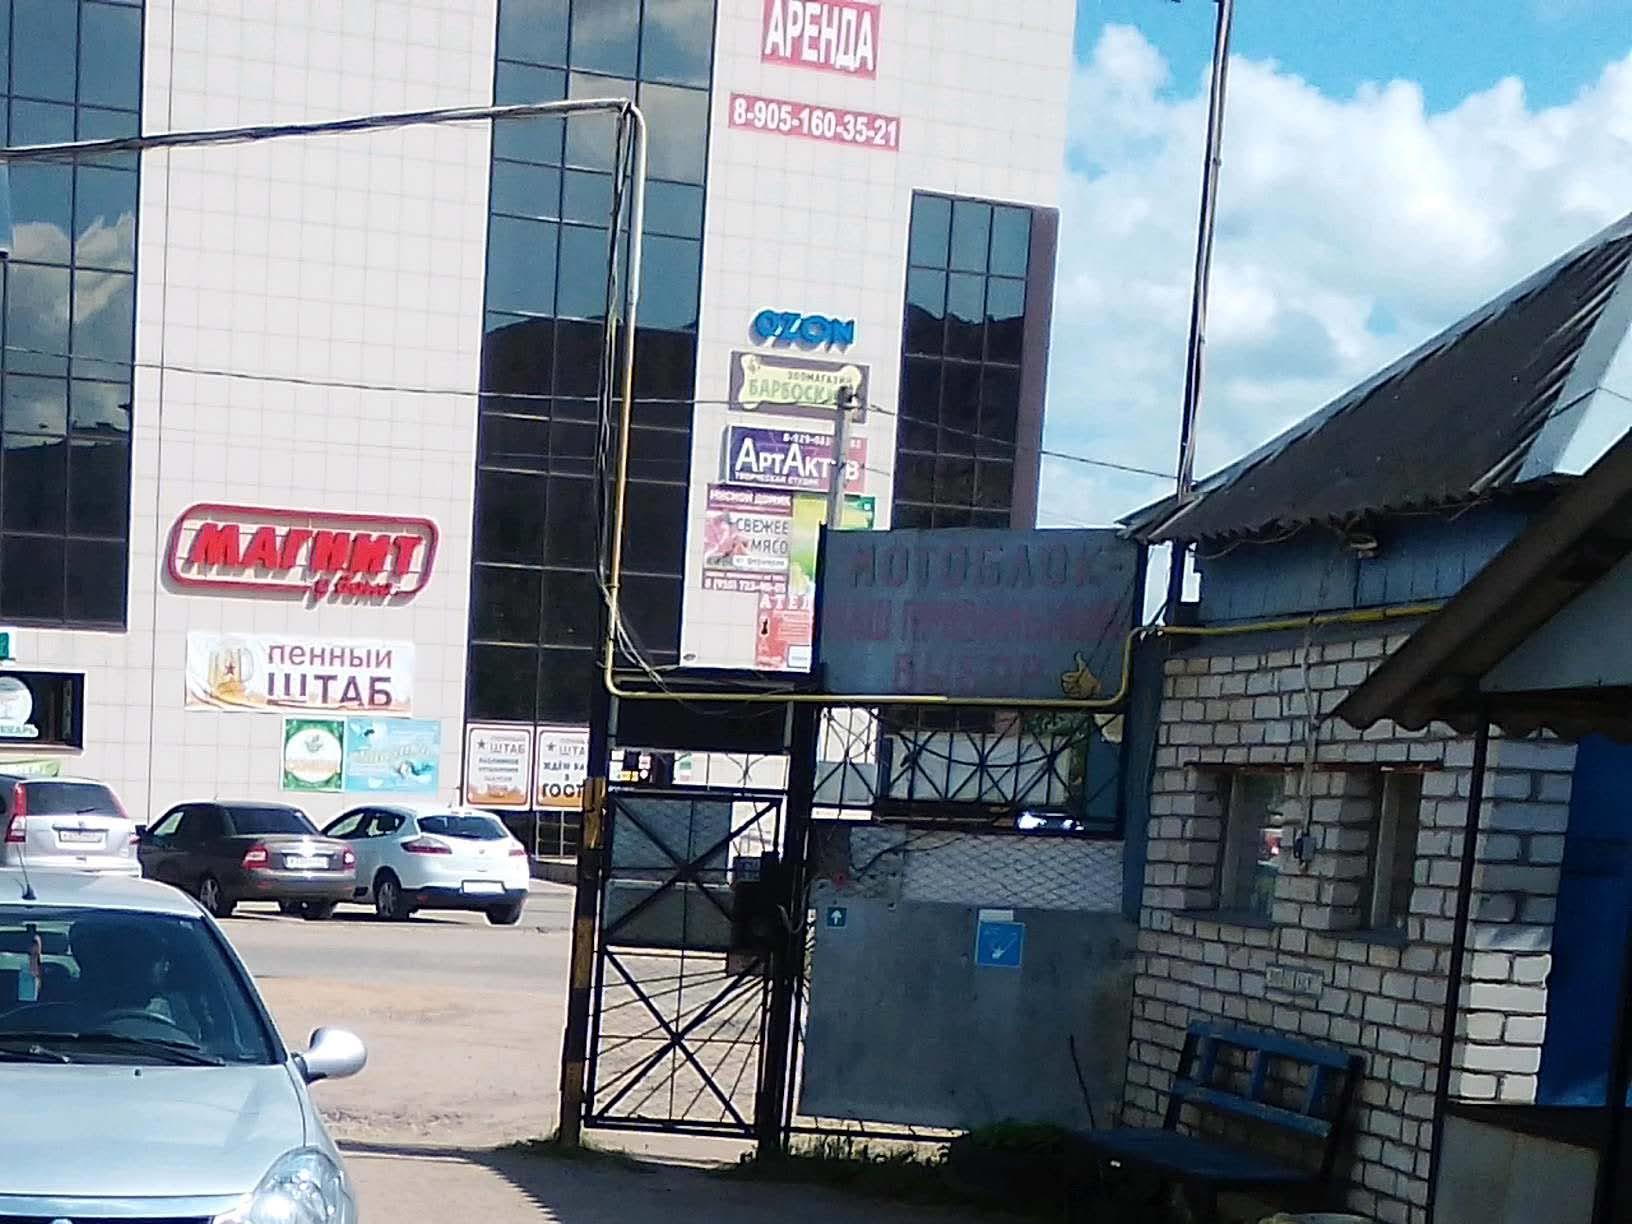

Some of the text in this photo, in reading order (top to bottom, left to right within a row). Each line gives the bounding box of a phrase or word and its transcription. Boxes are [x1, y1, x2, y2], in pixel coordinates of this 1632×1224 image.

[765, 1, 875, 72] АРЕНДА
[733, 98, 898, 147] 8-905-160-35-21
[752, 309, 855, 347] OZON
[735, 518, 789, 535] СВЕЖЕЕ
[191, 522, 424, 575] МАГНИТ
[751, 539, 788, 554] МЯСО
[267, 672, 393, 707] ШТАБ
[489, 742, 526, 755] ШТАБ
[559, 745, 585, 756] ШТА
[542, 783, 584, 798] ГОСТ
